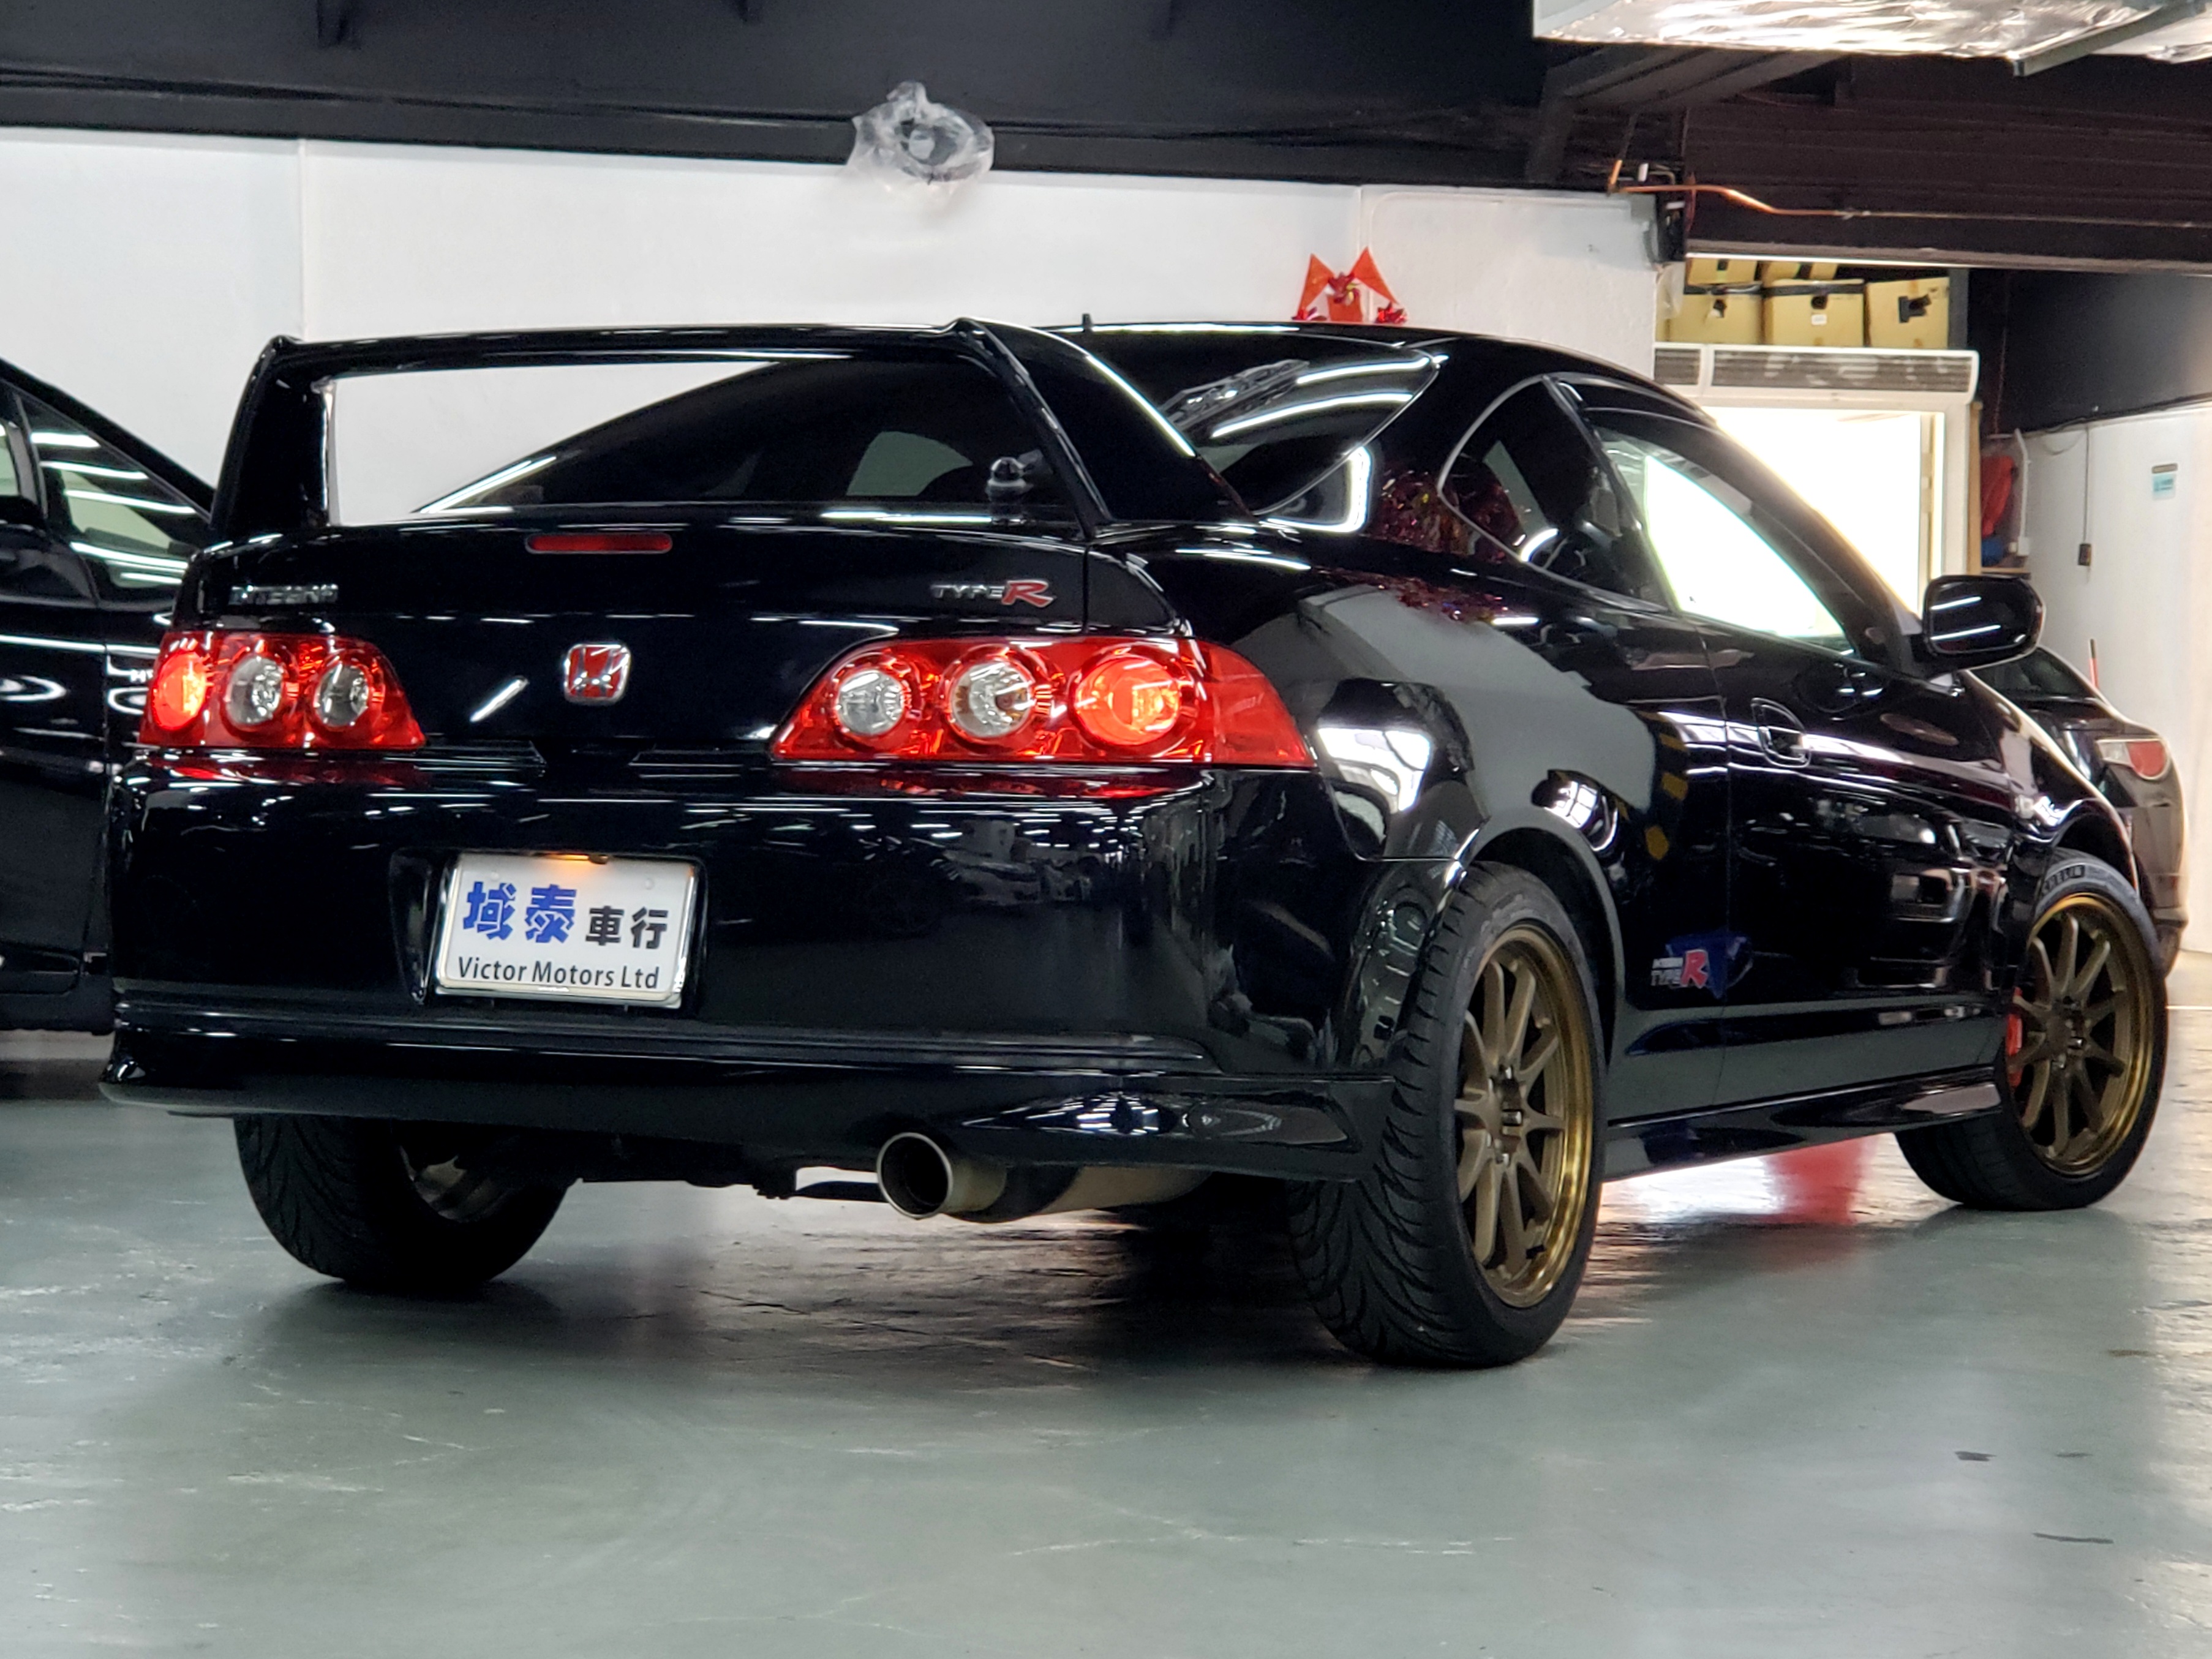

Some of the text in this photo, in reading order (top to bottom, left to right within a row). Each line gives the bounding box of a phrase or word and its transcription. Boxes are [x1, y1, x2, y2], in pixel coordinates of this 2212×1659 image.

[462, 881, 669, 950] 域泰車行
[458, 956, 660, 990] Victor Motors Ltd
